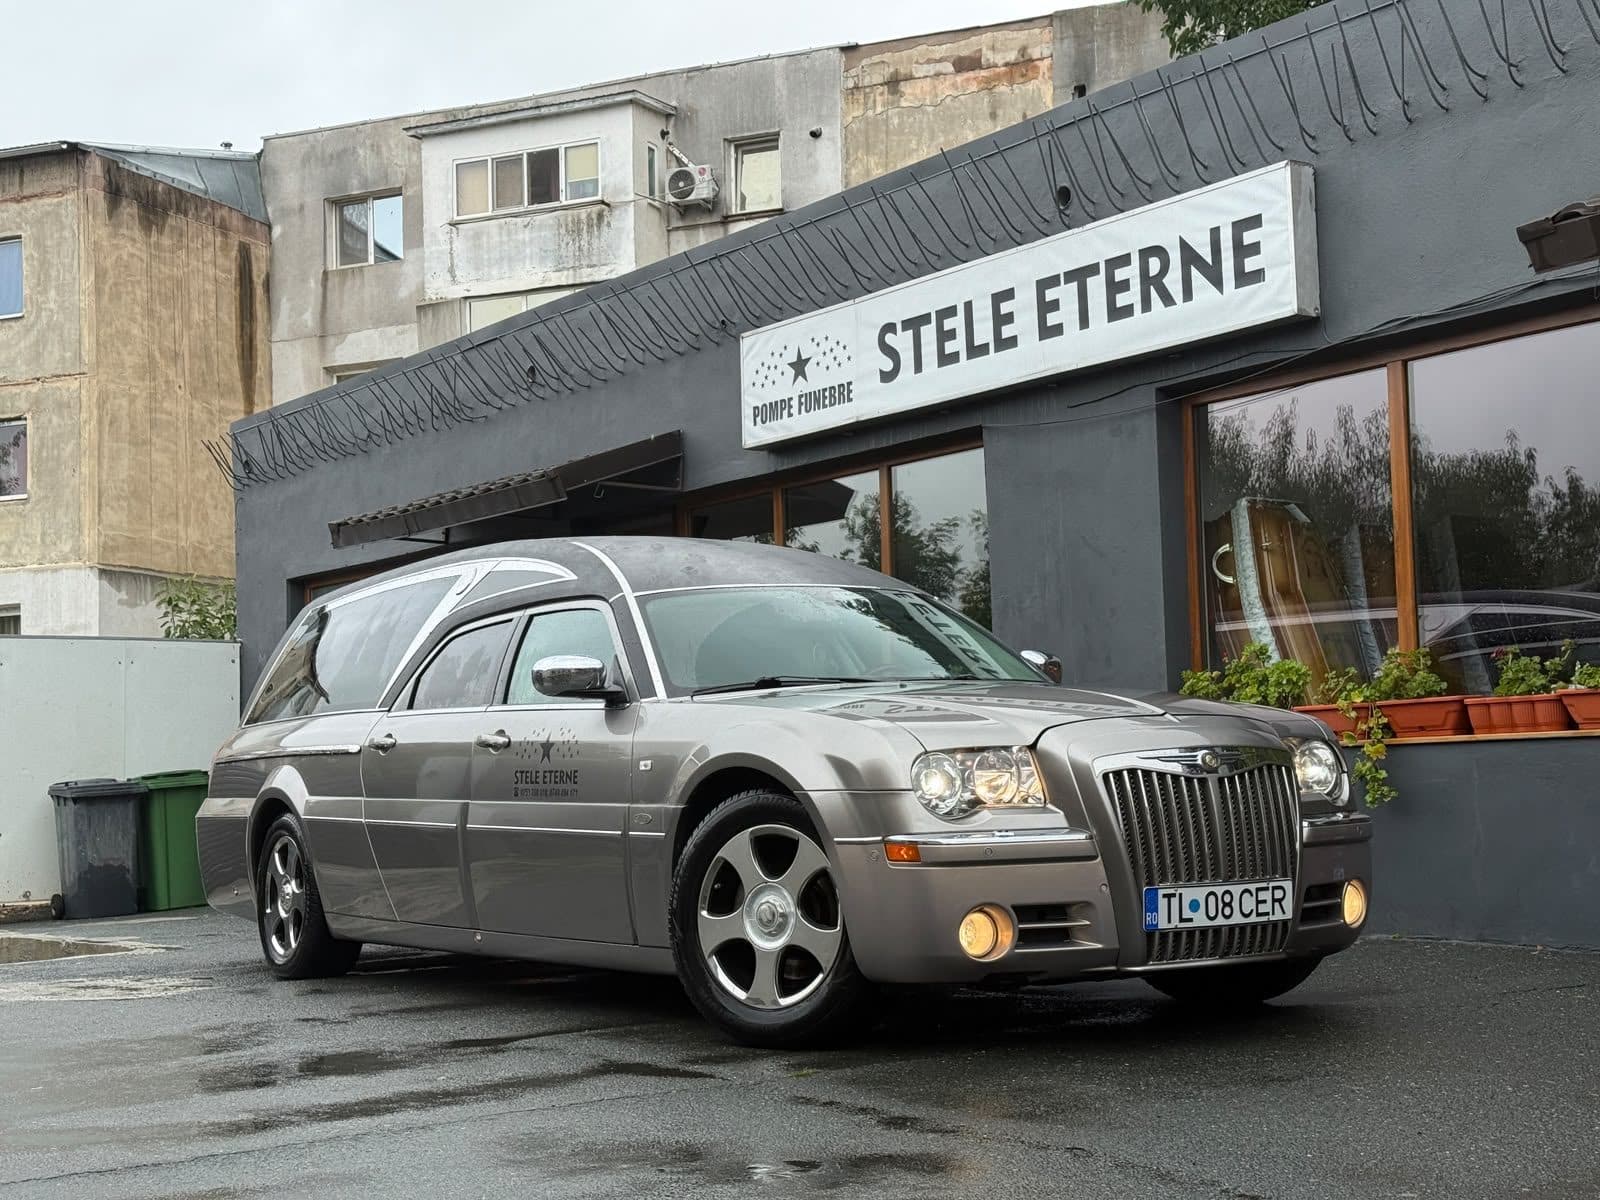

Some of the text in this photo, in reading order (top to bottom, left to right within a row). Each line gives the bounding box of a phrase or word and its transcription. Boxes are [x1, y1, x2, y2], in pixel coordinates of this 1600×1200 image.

[877, 213, 1266, 384] STELE ETERNE
[752, 381, 853, 427] POMPE FUNEBRE
[514, 769, 578, 785] STELE ETERNE
[1146, 912, 1158, 925] RO
[1162, 885, 1286, 924] TL 08 CER
